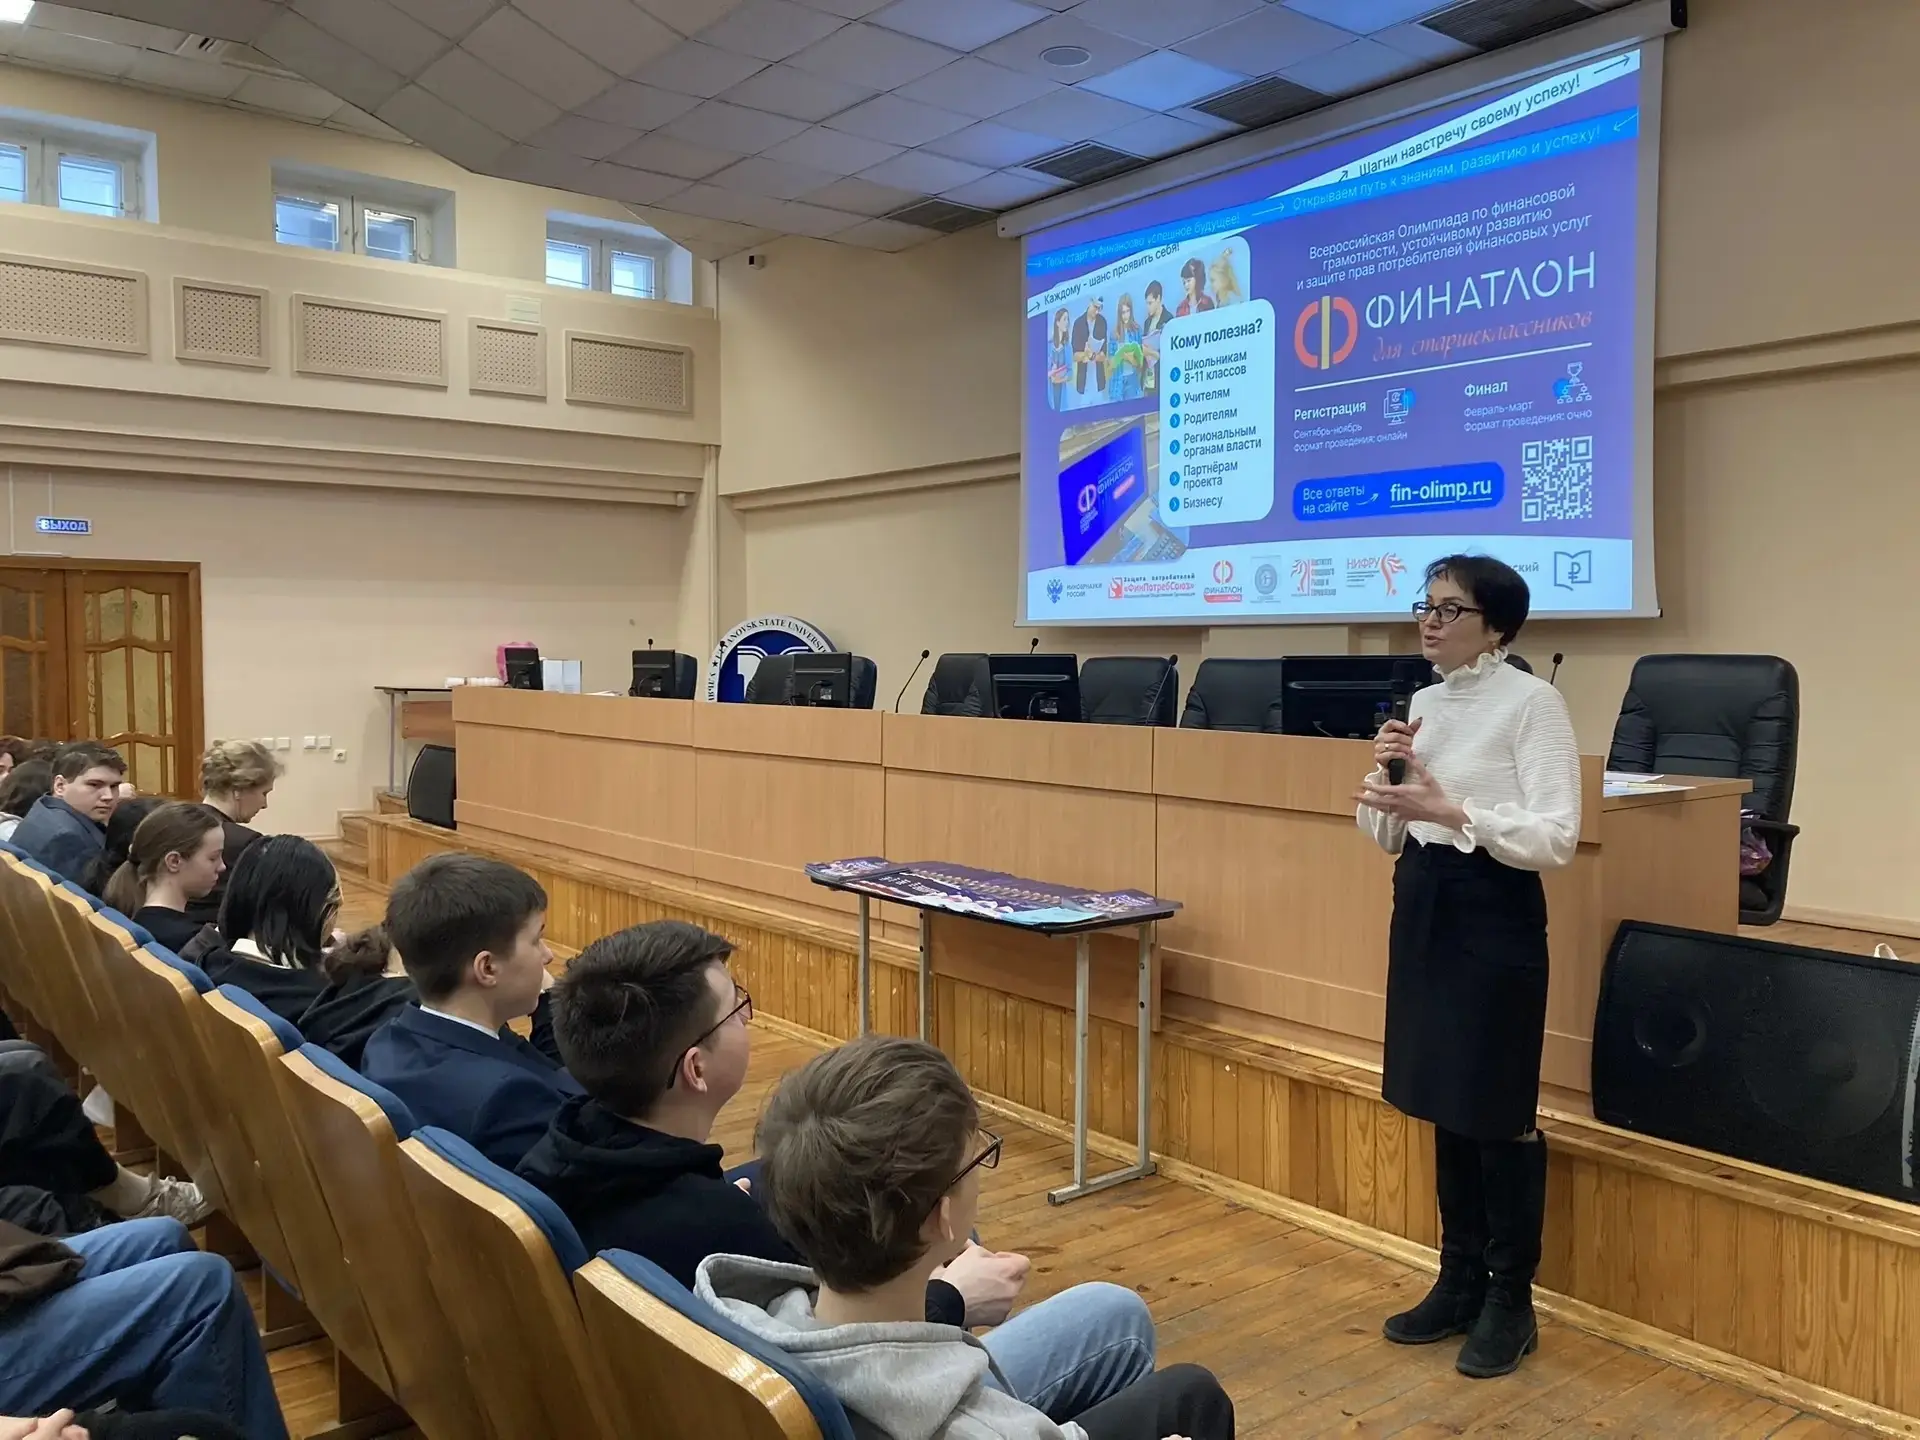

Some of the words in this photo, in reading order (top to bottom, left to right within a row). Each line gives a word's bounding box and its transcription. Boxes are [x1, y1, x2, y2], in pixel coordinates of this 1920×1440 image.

[1359, 152, 1398, 177] Шагни
[1400, 122, 1467, 161] навстречу
[1470, 100, 1522, 132] своему
[1525, 74, 1581, 112] успеху!
[1292, 183, 1358, 210] Открываем
[1360, 177, 1388, 198] путь
[1389, 176, 1397, 189] к
[1400, 162, 1455, 186] знаниям,
[1461, 142, 1527, 172] развитию
[1531, 142, 1540, 154] и
[1544, 126, 1601, 156] успеху!
[1309, 229, 1394, 260] Всероссийская
[1398, 211, 1469, 238] Олимпиада
[1472, 207, 1488, 223] по
[1491, 183, 1576, 218] финансовой
[1065, 249, 1088, 266] старт
[1194, 214, 1241, 234] будущее!
[1322, 242, 1399, 273] грамотности,
[1401, 222, 1483, 257] устойчивому
[1486, 207, 1552, 236] развитию
[1296, 279, 1303, 291] и
[1306, 268, 1346, 289] защите
[1348, 263, 1375, 283] прав
[1378, 240, 1463, 275] потребителей
[1465, 226, 1549, 257] финансовых
[1552, 214, 1593, 238] услуг
[1044, 283, 1081, 305] Каждому
[1089, 272, 1111, 288] шанс
[1112, 254, 1154, 279] проявить
[1155, 242, 1180, 260] себя!
[1365, 251, 1596, 329] ФИНАТЛОН
[1170, 332, 1202, 350] Кому
[1204, 318, 1263, 344] полезна?
[1372, 337, 1402, 362] для
[1411, 310, 1593, 361] старшеклассников
[1184, 350, 1247, 372] Школьникам
[1184, 370, 1204, 385] 8-11
[1206, 364, 1246, 382] классов
[1184, 387, 1230, 404] Учителям
[1464, 380, 1508, 397] Финал
[1184, 407, 1238, 426] Родителям
[1294, 401, 1367, 422] Регистрация
[1463, 400, 1534, 418] Февраль-март
[1463, 419, 1500, 433] Формат
[1502, 412, 1565, 430] проведения:
[1566, 408, 1593, 421] очно
[1184, 425, 1257, 445] Региональным
[1293, 423, 1363, 440] Сентябрь-ноябрь
[1293, 441, 1323, 454] Формат
[1325, 434, 1376, 451] проведения:
[1377, 430, 1408, 444] онлайн
[1183, 441, 1224, 460] органам
[1226, 437, 1262, 451] власти
[1184, 459, 1238, 478] Партнёрам
[1183, 475, 1223, 491] проекта
[1303, 486, 1323, 501] Все
[1325, 483, 1365, 499] ответы
[1389, 477, 1492, 503] fin-olimp.ru
[1183, 495, 1223, 510] Бизнесу
[1303, 502, 1317, 515] на
[1318, 498, 1349, 513] сайте
[40, 519, 87, 531] ВЫХОД
[1204, 586, 1243, 594] ФИНАТЛОН
[759, 618, 786, 627] STATE
